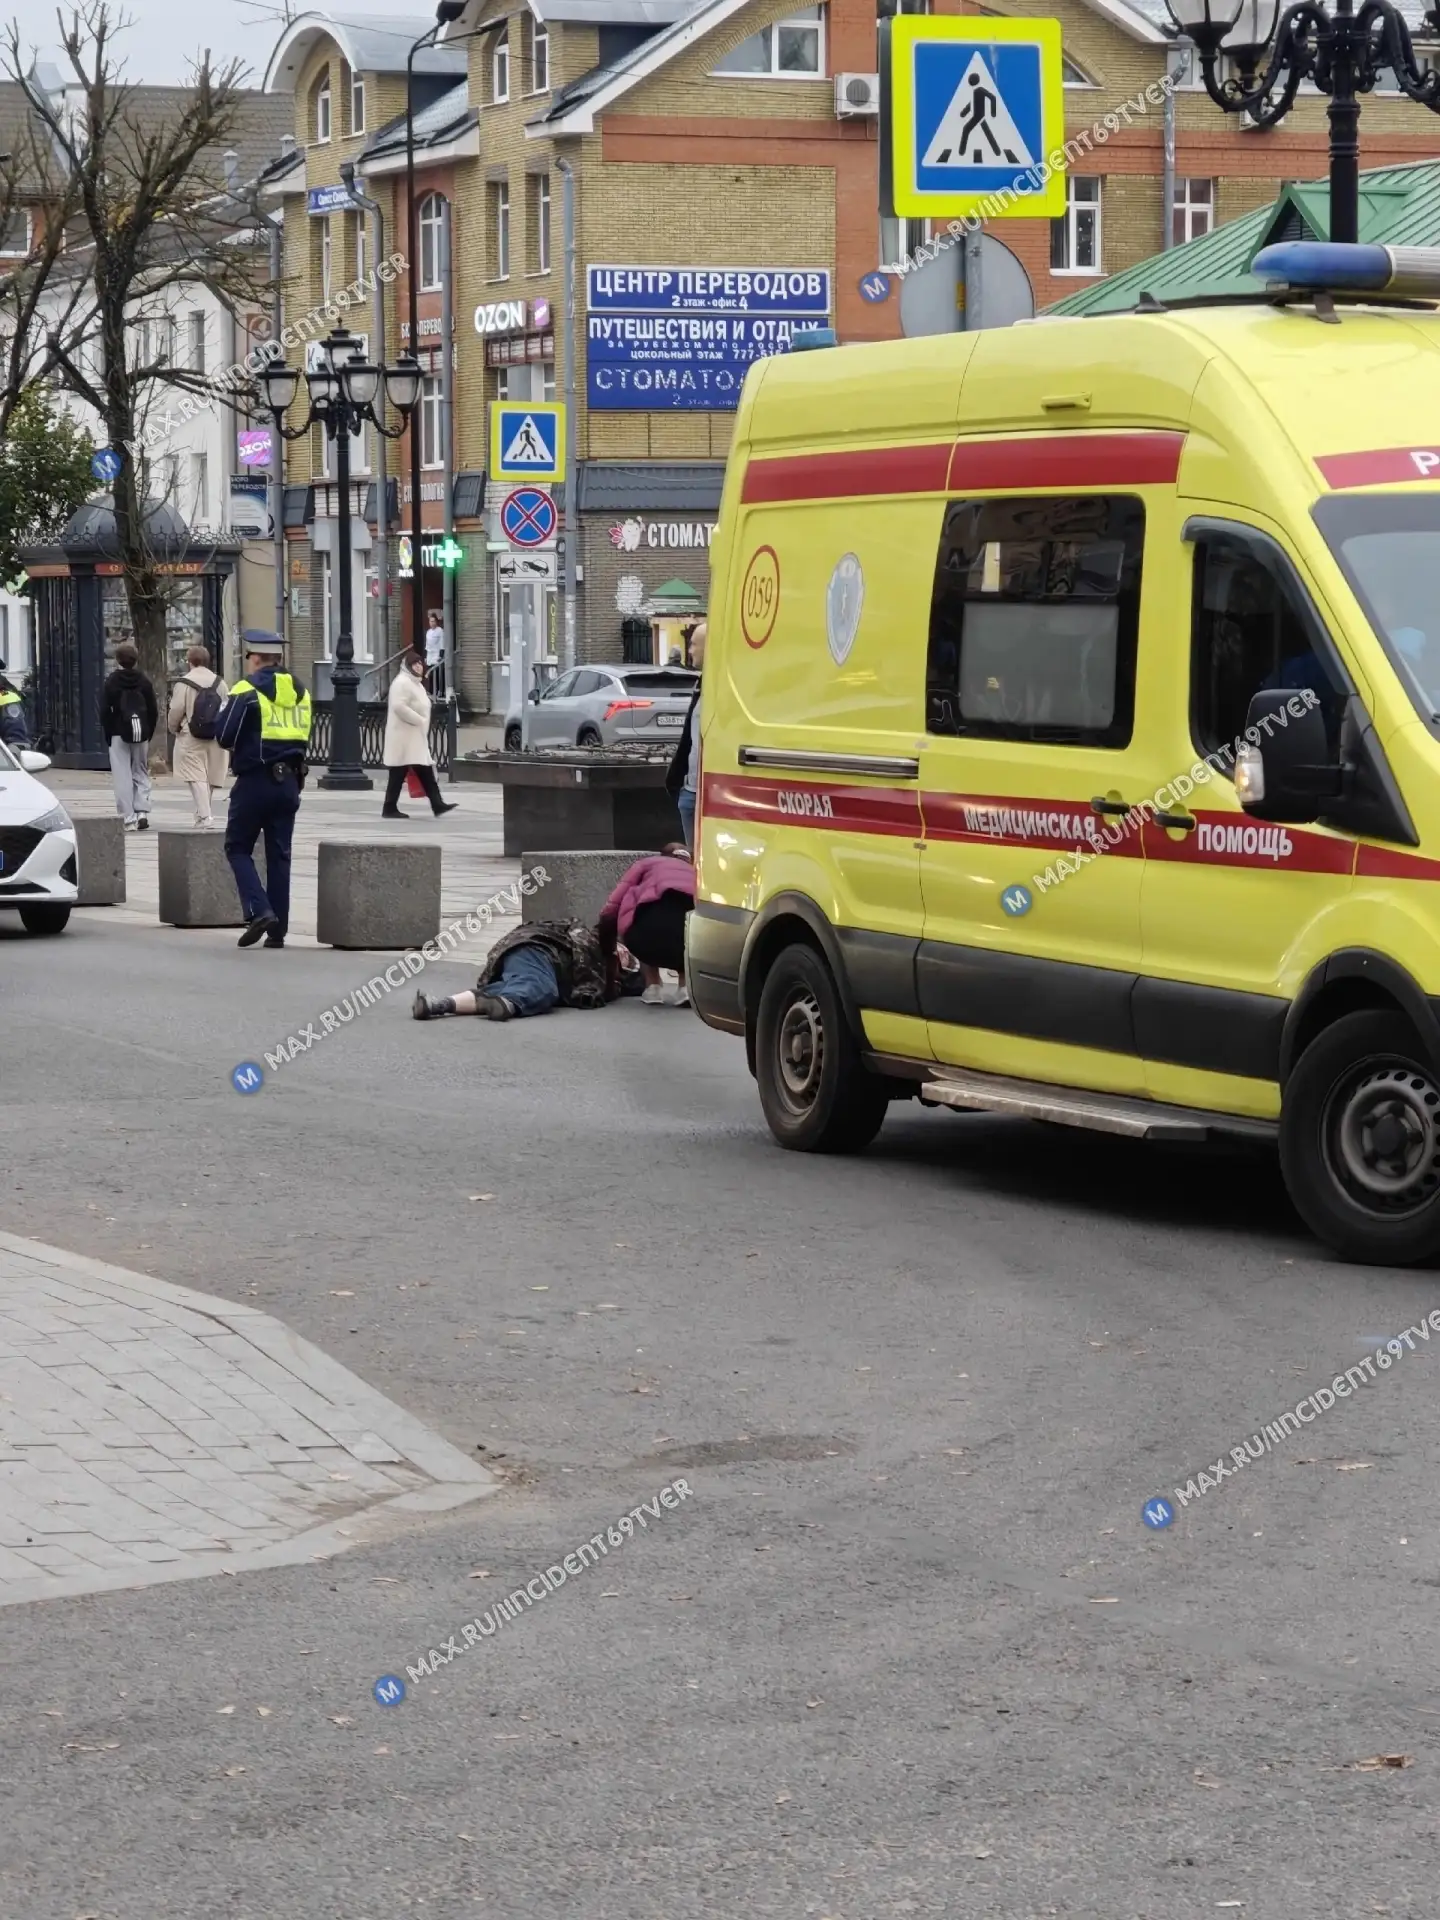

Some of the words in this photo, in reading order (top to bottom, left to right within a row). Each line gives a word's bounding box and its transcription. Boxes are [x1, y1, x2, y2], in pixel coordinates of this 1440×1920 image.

[596, 271, 672, 297] ЦЕНТР
[678, 272, 821, 299] ПЕРЕВОДОВ
[671, 295, 681, 307] 2
[683, 298, 706, 307] этаж
[712, 296, 737, 309] офис
[739, 296, 748, 310] 4
[475, 300, 525, 333] OZON
[589, 318, 727, 339] ПУТЕШЕСТВИЯ
[733, 320, 745, 340] И
[608, 340, 624, 349] ЗА
[633, 341, 702, 349] РУБЕЖОМ
[708, 341, 715, 349] И
[631, 349, 692, 359] ЦОКОЛЬНЫЙ
[697, 350, 723, 359] ЭТАЖ
[748, 575, 773, 619] 059
[267, 705, 308, 728] ДПС
[777, 791, 834, 818] СКОРАЯ
[964, 807, 1096, 840] МЕДИЦИНСКАЯ
[1198, 824, 1293, 861] ПОМОЩЬ
